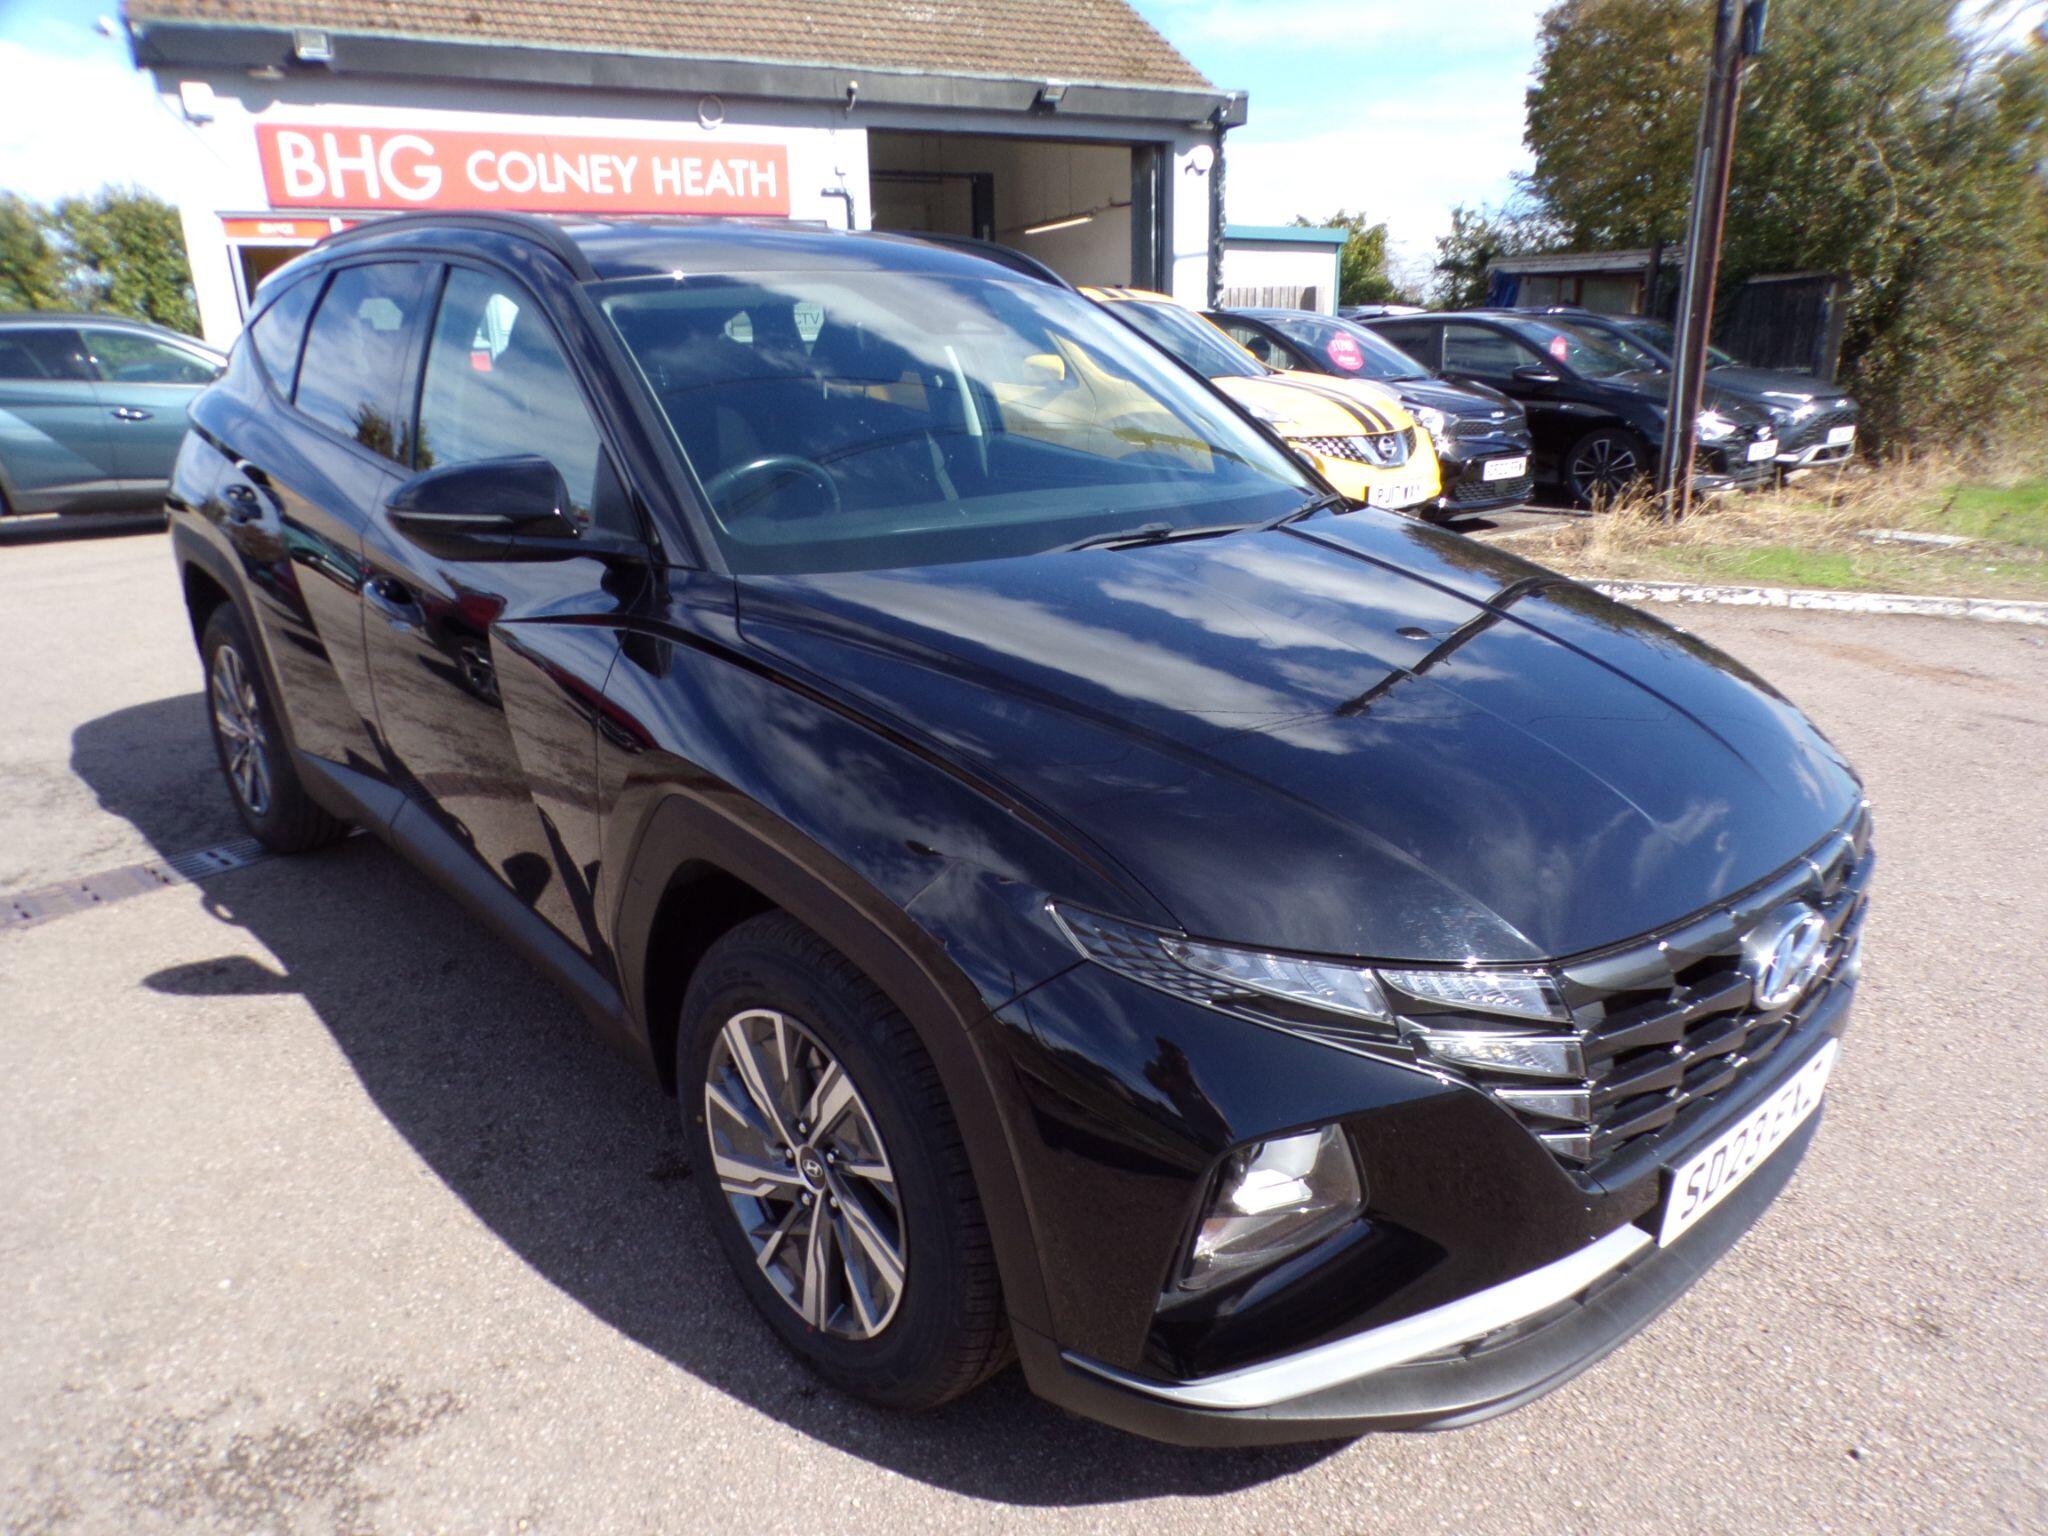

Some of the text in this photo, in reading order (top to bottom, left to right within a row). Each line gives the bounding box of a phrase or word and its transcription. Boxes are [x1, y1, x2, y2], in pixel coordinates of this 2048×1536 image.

[276, 131, 777, 201] BHG COLNEY HEATH
[1681, 1112, 1767, 1220] SD23
